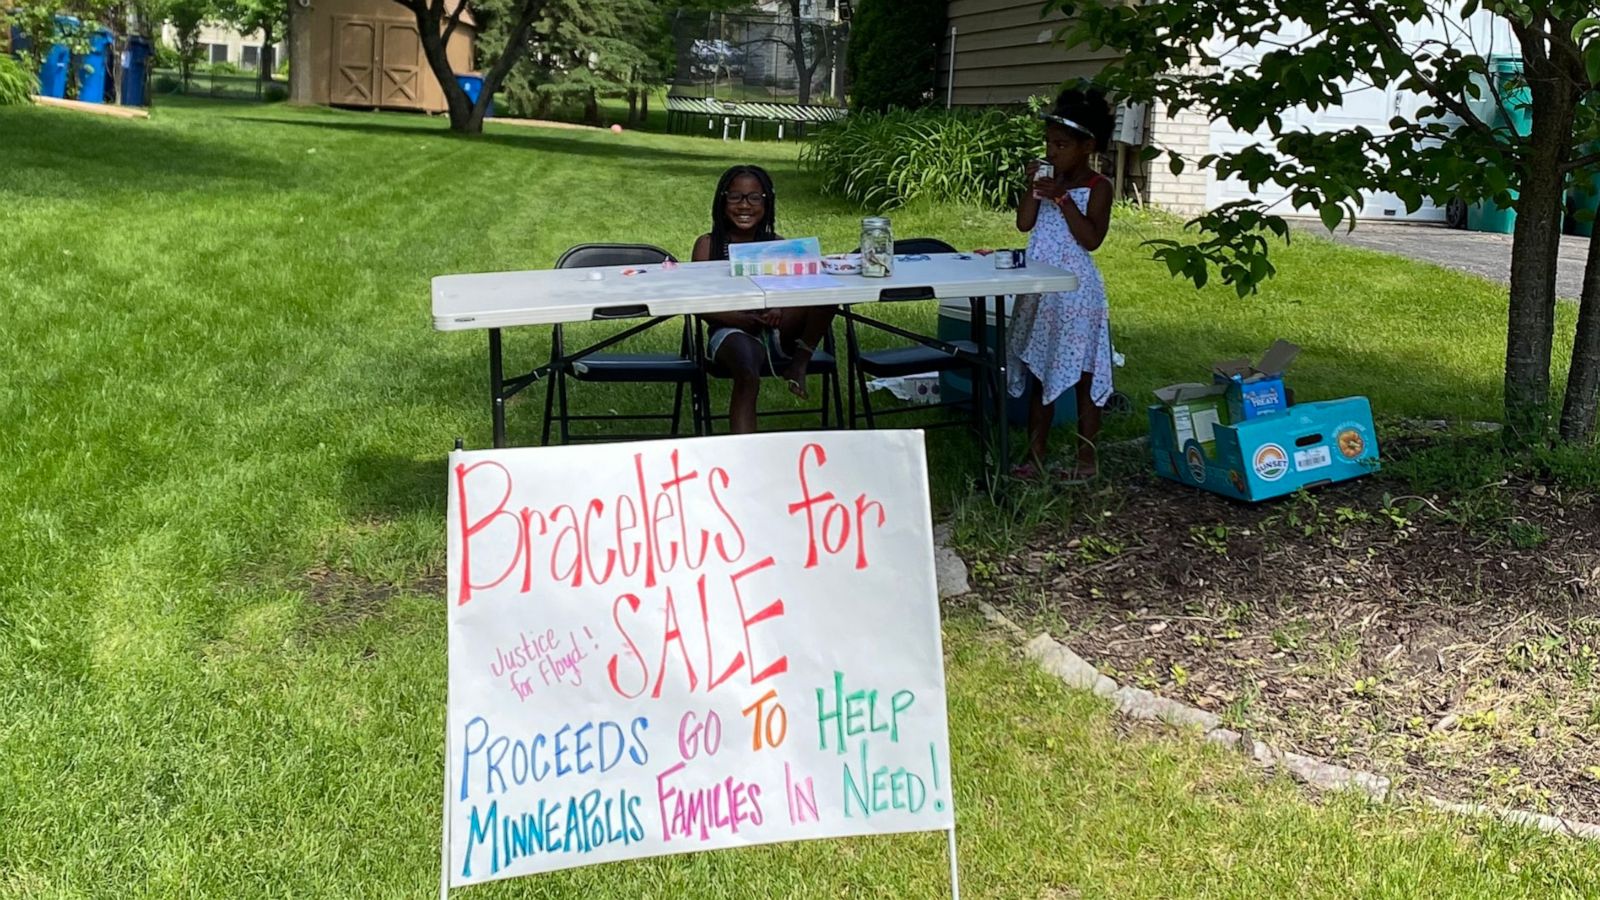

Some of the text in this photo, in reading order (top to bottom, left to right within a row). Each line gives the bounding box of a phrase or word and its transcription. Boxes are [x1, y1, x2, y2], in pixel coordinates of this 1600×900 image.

[455, 443, 885, 606] Bracelets for
[1256, 460, 1288, 472] SUNSET
[490, 628, 560, 677] Justice
[510, 626, 598, 702] for Floyd!
[607, 556, 788, 699] SALE
[460, 671, 914, 802] PROCEEDS GO TO HELP
[462, 739, 944, 878] MINNEAPOLIS FAMILIES IN NEED!
